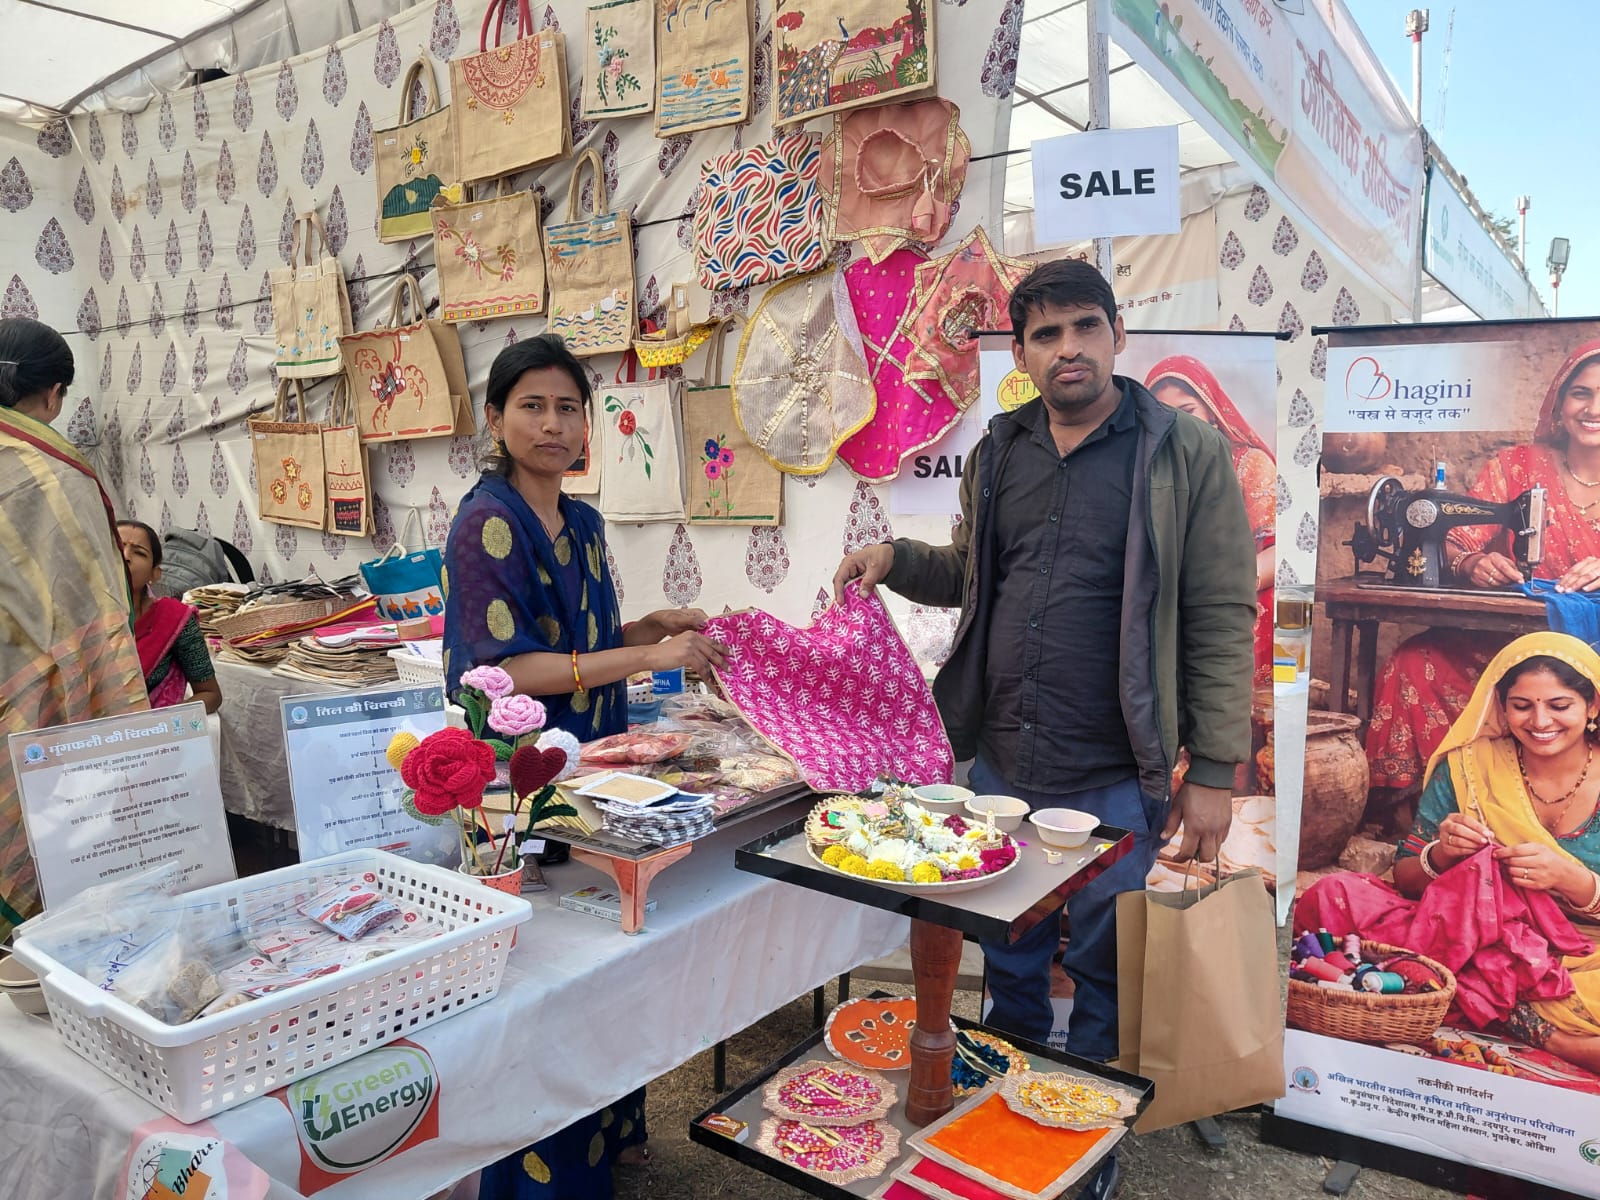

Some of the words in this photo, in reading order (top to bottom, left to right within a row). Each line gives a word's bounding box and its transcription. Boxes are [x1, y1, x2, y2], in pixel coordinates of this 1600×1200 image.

[1059, 168, 1156, 199] SALE
[1116, 263, 1132, 277] हेतु
[1345, 356, 1472, 405] Bhagini
[1385, 405, 1397, 420] से
[1400, 408, 1433, 425] वजूद
[913, 455, 963, 478] SAL
[316, 705, 342, 717] तिल
[345, 702, 362, 714] की
[363, 696, 406, 712] चिक्की
[104, 730, 123, 745] की
[124, 721, 169, 742] चिक्की
[332, 1061, 412, 1104] Green
[1416, 1076, 1454, 1092] तकनीकी
[1455, 1083, 1494, 1101] मार्गदर्शन
[341, 1074, 433, 1131] Energy
[1327, 1072, 1354, 1086] अखिल
[1355, 1079, 1386, 1092] भारतीय
[1388, 1086, 1421, 1101] समन्वित
[1423, 1094, 1453, 1109] कृषिरत
[1455, 1101, 1483, 1116] महिला
[1485, 1109, 1527, 1126] अनुसंधान
[1529, 1118, 1575, 1137] परियोजना
[1437, 1117, 1460, 1131] महिला
[1513, 1126, 1547, 1142] राजस्थान
